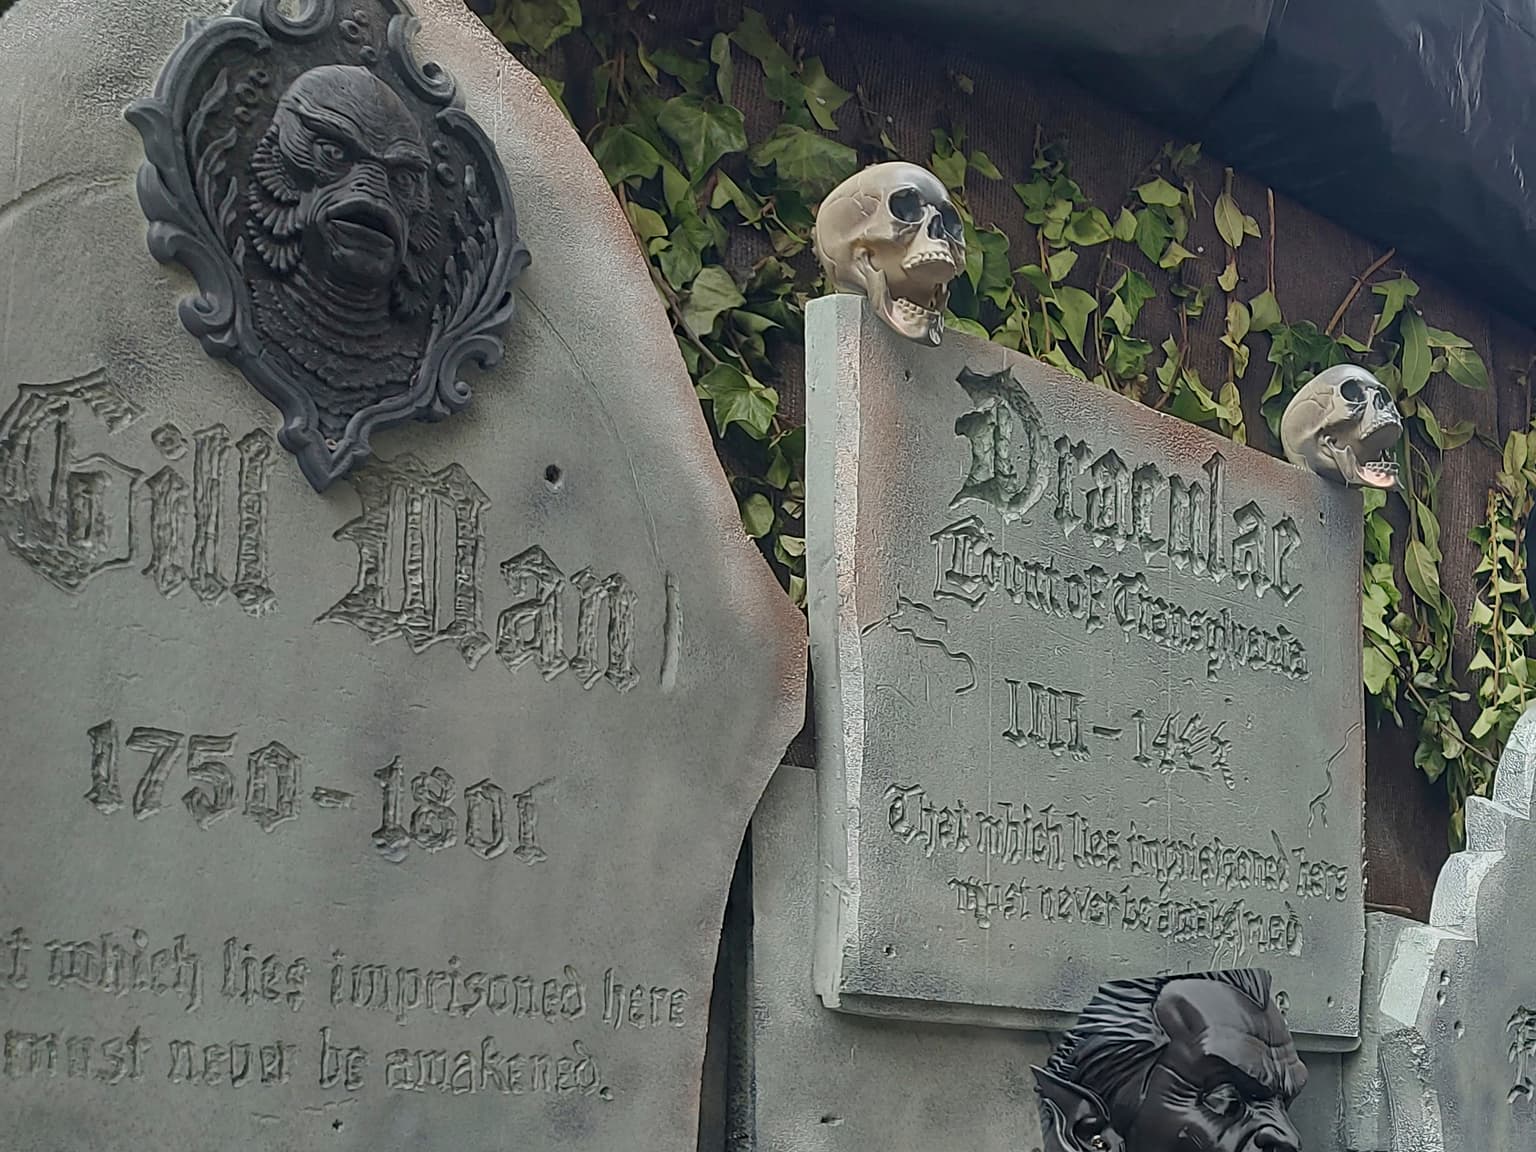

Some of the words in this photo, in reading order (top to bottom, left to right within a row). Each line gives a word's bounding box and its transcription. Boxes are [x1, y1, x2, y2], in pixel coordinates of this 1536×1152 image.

[1, 366, 277, 617] Gill
[975, 802, 1065, 871] which
[1066, 811, 1121, 873] lies
[1292, 847, 1348, 901] here
[1037, 884, 1120, 929] never
[1120, 884, 1152, 932] be
[44, 925, 201, 1013] which
[221, 935, 311, 1013] lies
[330, 949, 587, 1026] imprisoned
[602, 967, 689, 1031] here
[4, 1026, 152, 1086] must
[319, 1026, 369, 1092] be
